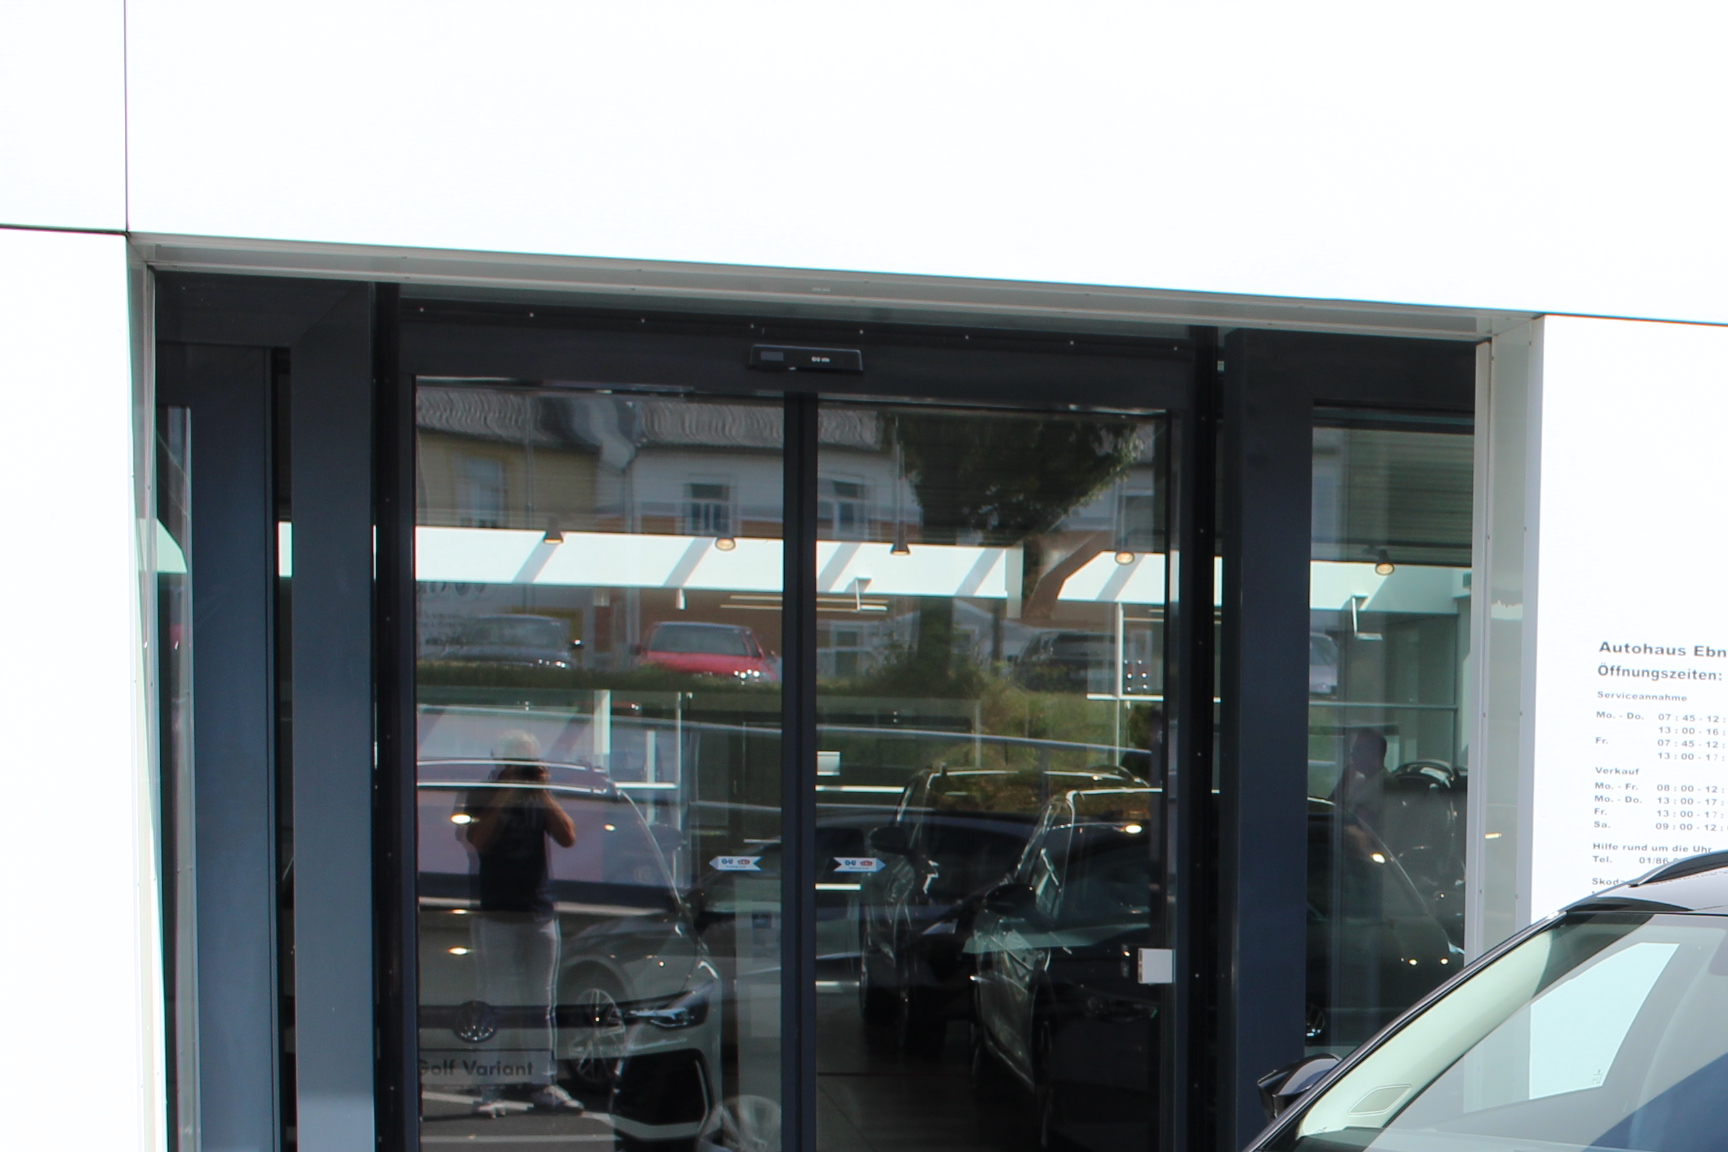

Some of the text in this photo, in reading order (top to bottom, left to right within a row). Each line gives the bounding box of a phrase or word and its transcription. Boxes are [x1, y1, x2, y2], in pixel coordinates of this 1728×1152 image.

[1599, 641, 1686, 656] Autohaus
[1598, 662, 1722, 681] Öffnungszeiten:
[1597, 691, 1687, 701] Serviceannahme
[1595, 767, 1639, 775] Verkauf
[1693, 845, 1713, 853] Uhr
[462, 1060, 534, 1076] Variant
